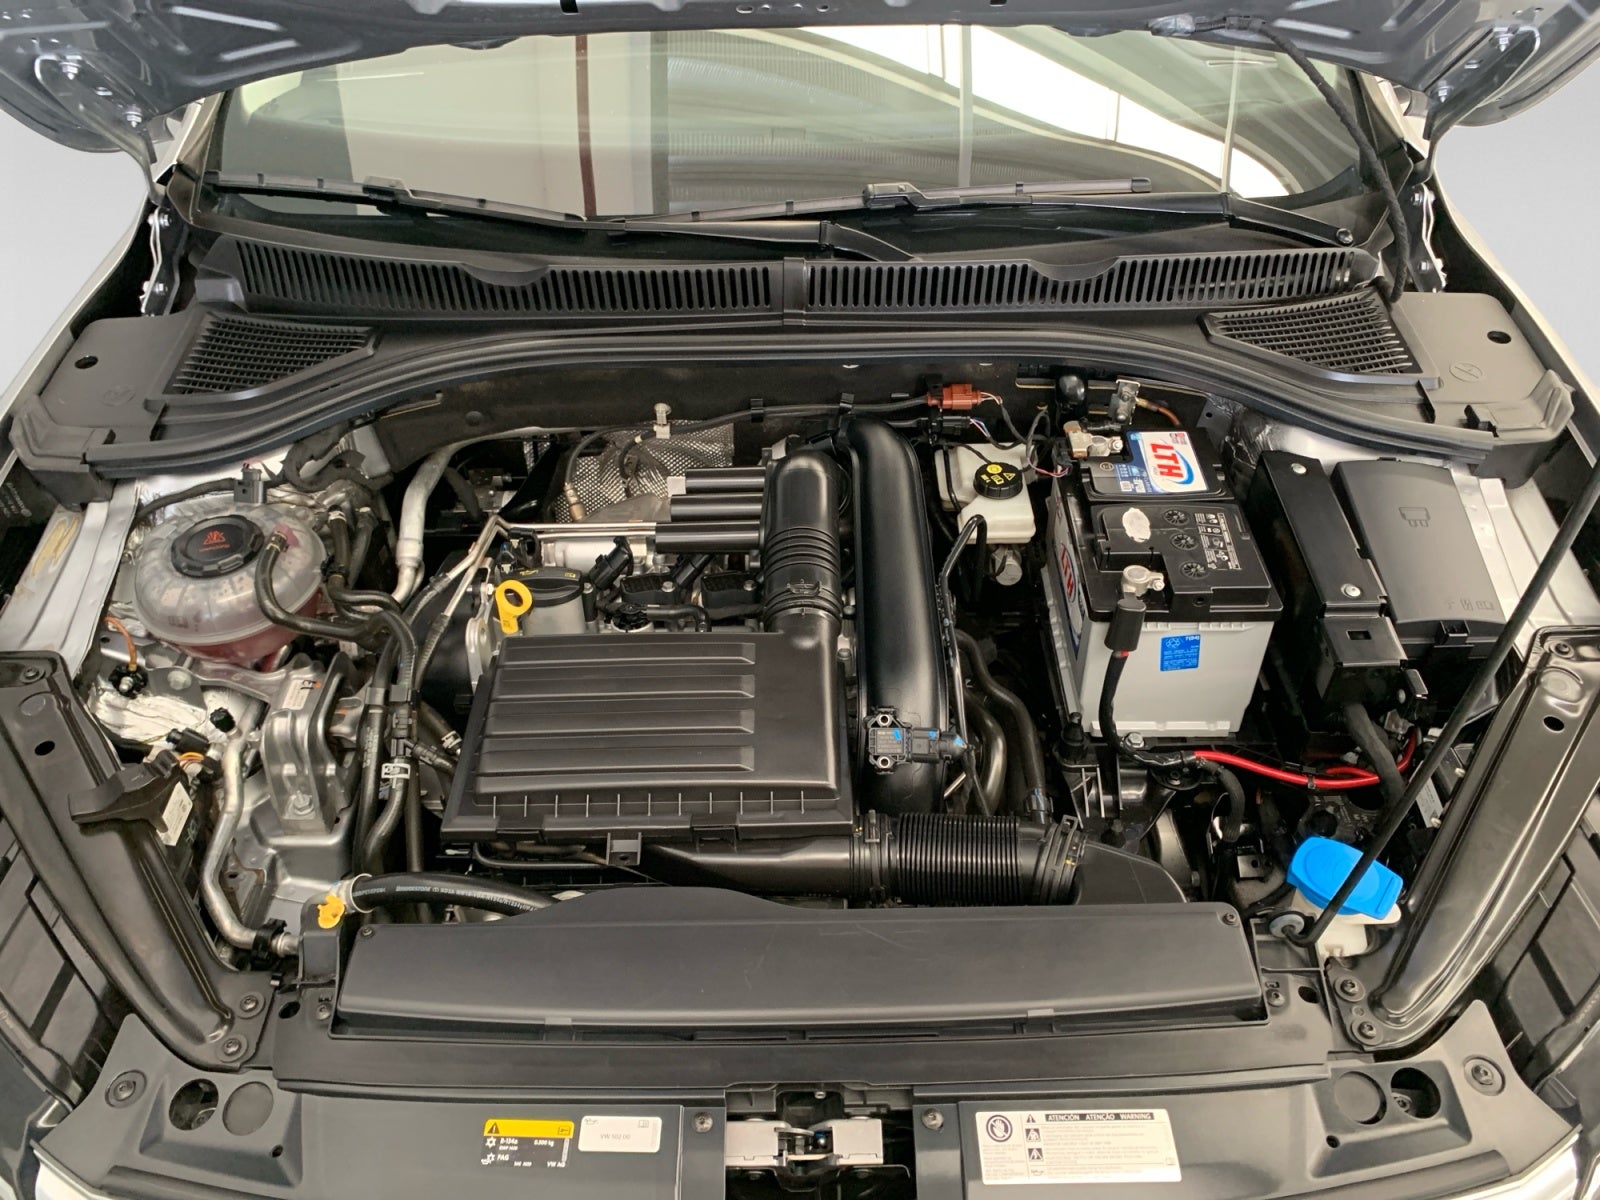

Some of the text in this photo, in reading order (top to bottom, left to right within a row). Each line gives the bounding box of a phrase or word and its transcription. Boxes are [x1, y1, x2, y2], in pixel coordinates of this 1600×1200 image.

[1150, 442, 1185, 478] LTH
[1047, 1112, 1152, 1122] ATENCIÓN ATENÇÃO WARNING
